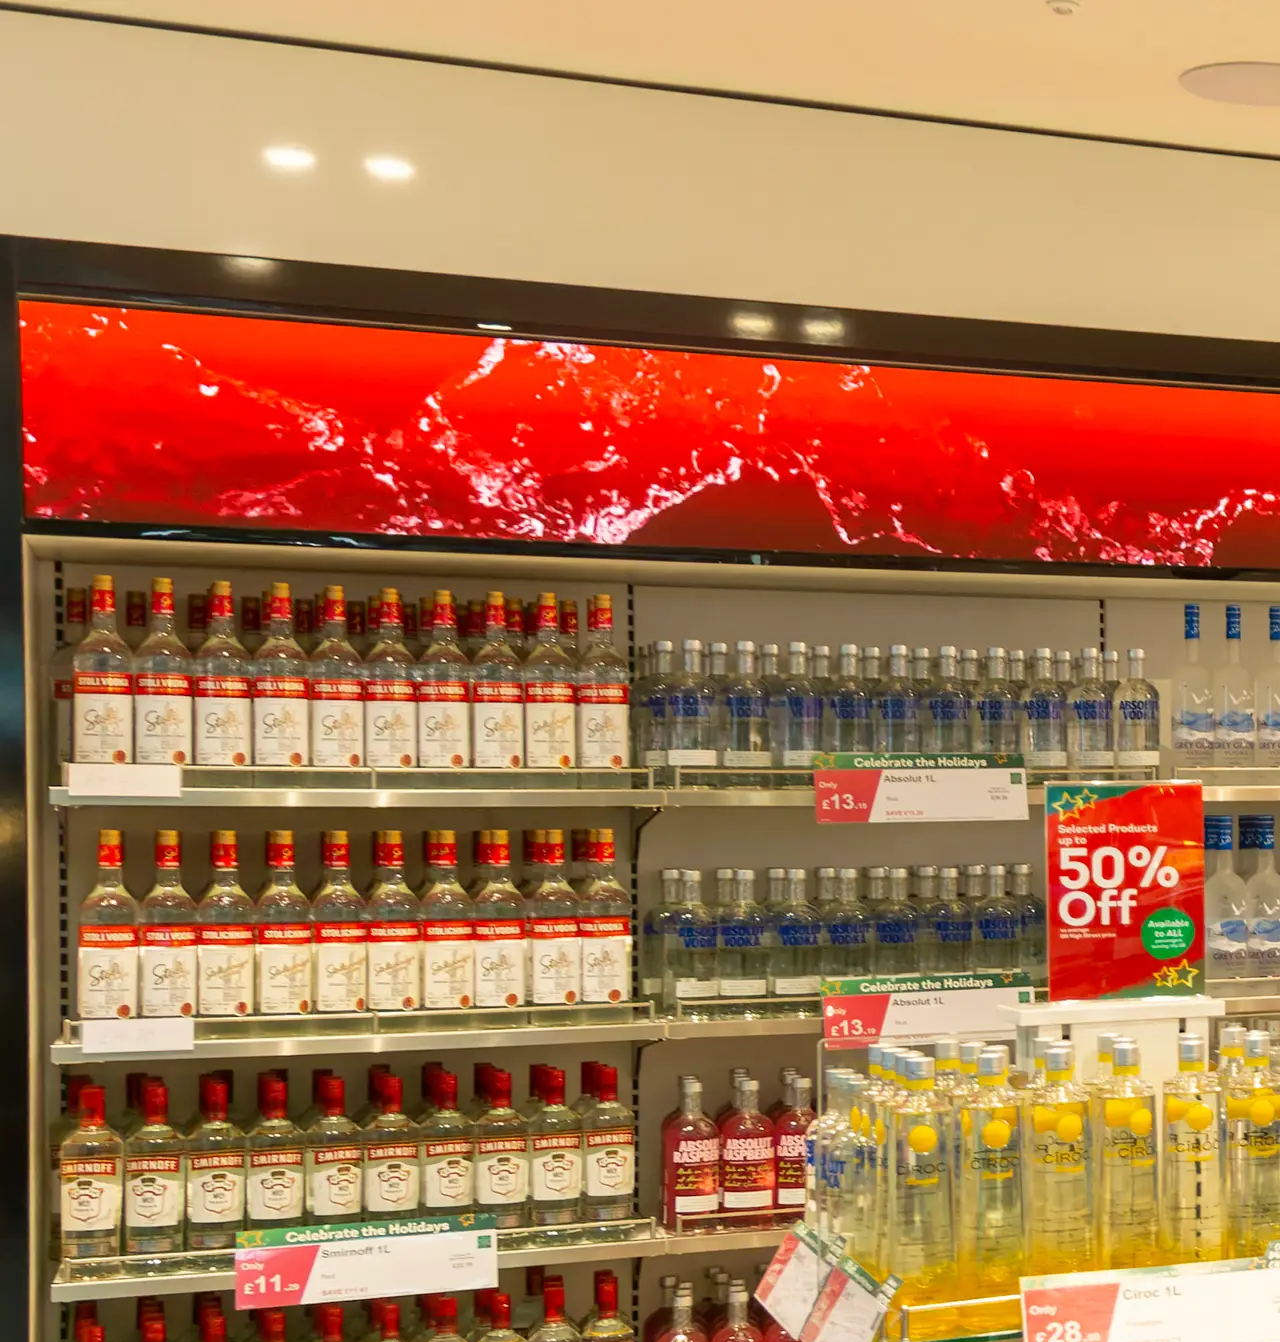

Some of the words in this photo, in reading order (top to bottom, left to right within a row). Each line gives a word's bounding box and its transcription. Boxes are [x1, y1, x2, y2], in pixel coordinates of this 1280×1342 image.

[853, 757, 914, 768] Celebrate
[916, 757, 936, 767] the
[938, 757, 988, 769] Holidays
[883, 775, 922, 783] Absolut
[925, 775, 936, 783] 1L
[819, 781, 839, 790] Only
[1058, 824, 1106, 834] Selected
[1108, 823, 1158, 834] Products
[1058, 838, 1073, 847] up
[1074, 836, 1087, 845] to
[1059, 845, 1180, 890] 50%
[1058, 888, 1139, 927] Off
[1148, 920, 1190, 928] Available
[1154, 930, 1165, 938] to
[1166, 929, 1184, 938] ALL
[860, 980, 919, 993] Celebrate
[922, 979, 942, 989] the
[943, 977, 994, 990] Holidays
[892, 998, 931, 1007] Absolut
[933, 996, 945, 1005] 1L
[588, 1134, 634, 1145] SMIRNOFF
[726, 1137, 773, 1149] ABSOLUT
[61, 1162, 114, 1175] SMIRNOFF
[285, 1230, 359, 1244] Celebrate
[362, 1227, 386, 1238] the
[388, 1221, 450, 1236] Holidays
[321, 1247, 374, 1259] Smirnoff
[378, 1245, 391, 1255] 1L
[240, 1262, 264, 1271] Only
[1123, 1287, 1160, 1301] Ciroc
[1165, 1286, 1181, 1297] 1L
[1029, 1305, 1058, 1317] Only
